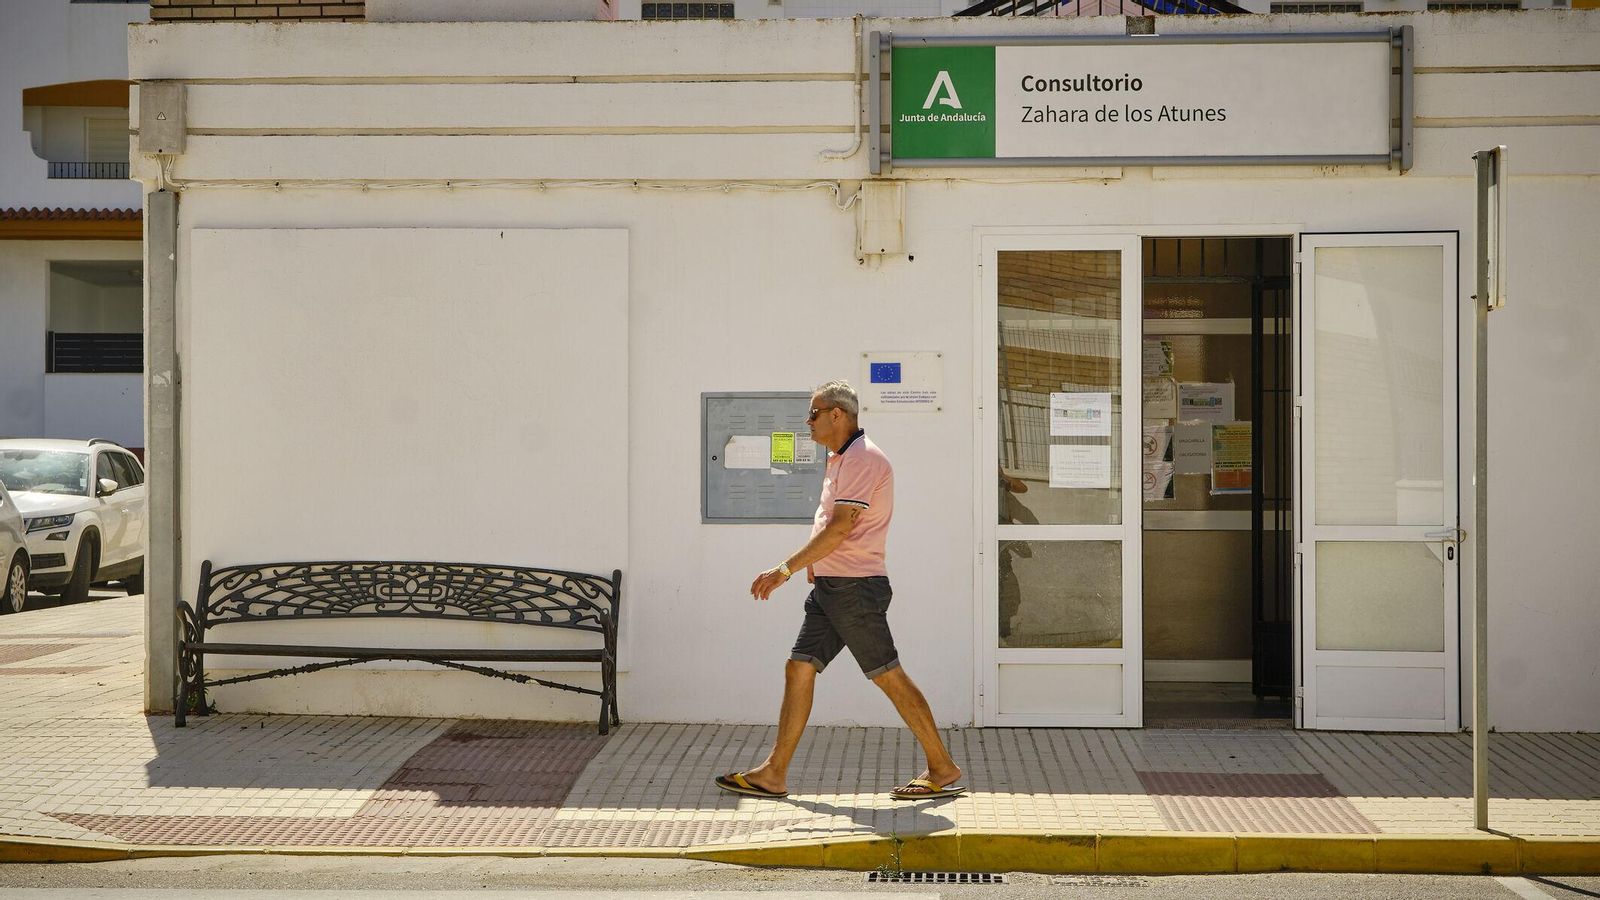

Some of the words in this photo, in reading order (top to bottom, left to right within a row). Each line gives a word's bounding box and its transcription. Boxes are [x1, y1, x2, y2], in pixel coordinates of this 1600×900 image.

[1021, 73, 1143, 92] Consultorio
[900, 113, 926, 122] Junta
[928, 113, 939, 122] de
[940, 112, 986, 122] Andalucía
[1021, 105, 1089, 123] Zahara
[1094, 105, 1119, 123] de
[1125, 104, 1153, 123] los
[1157, 105, 1227, 122] Atunes
